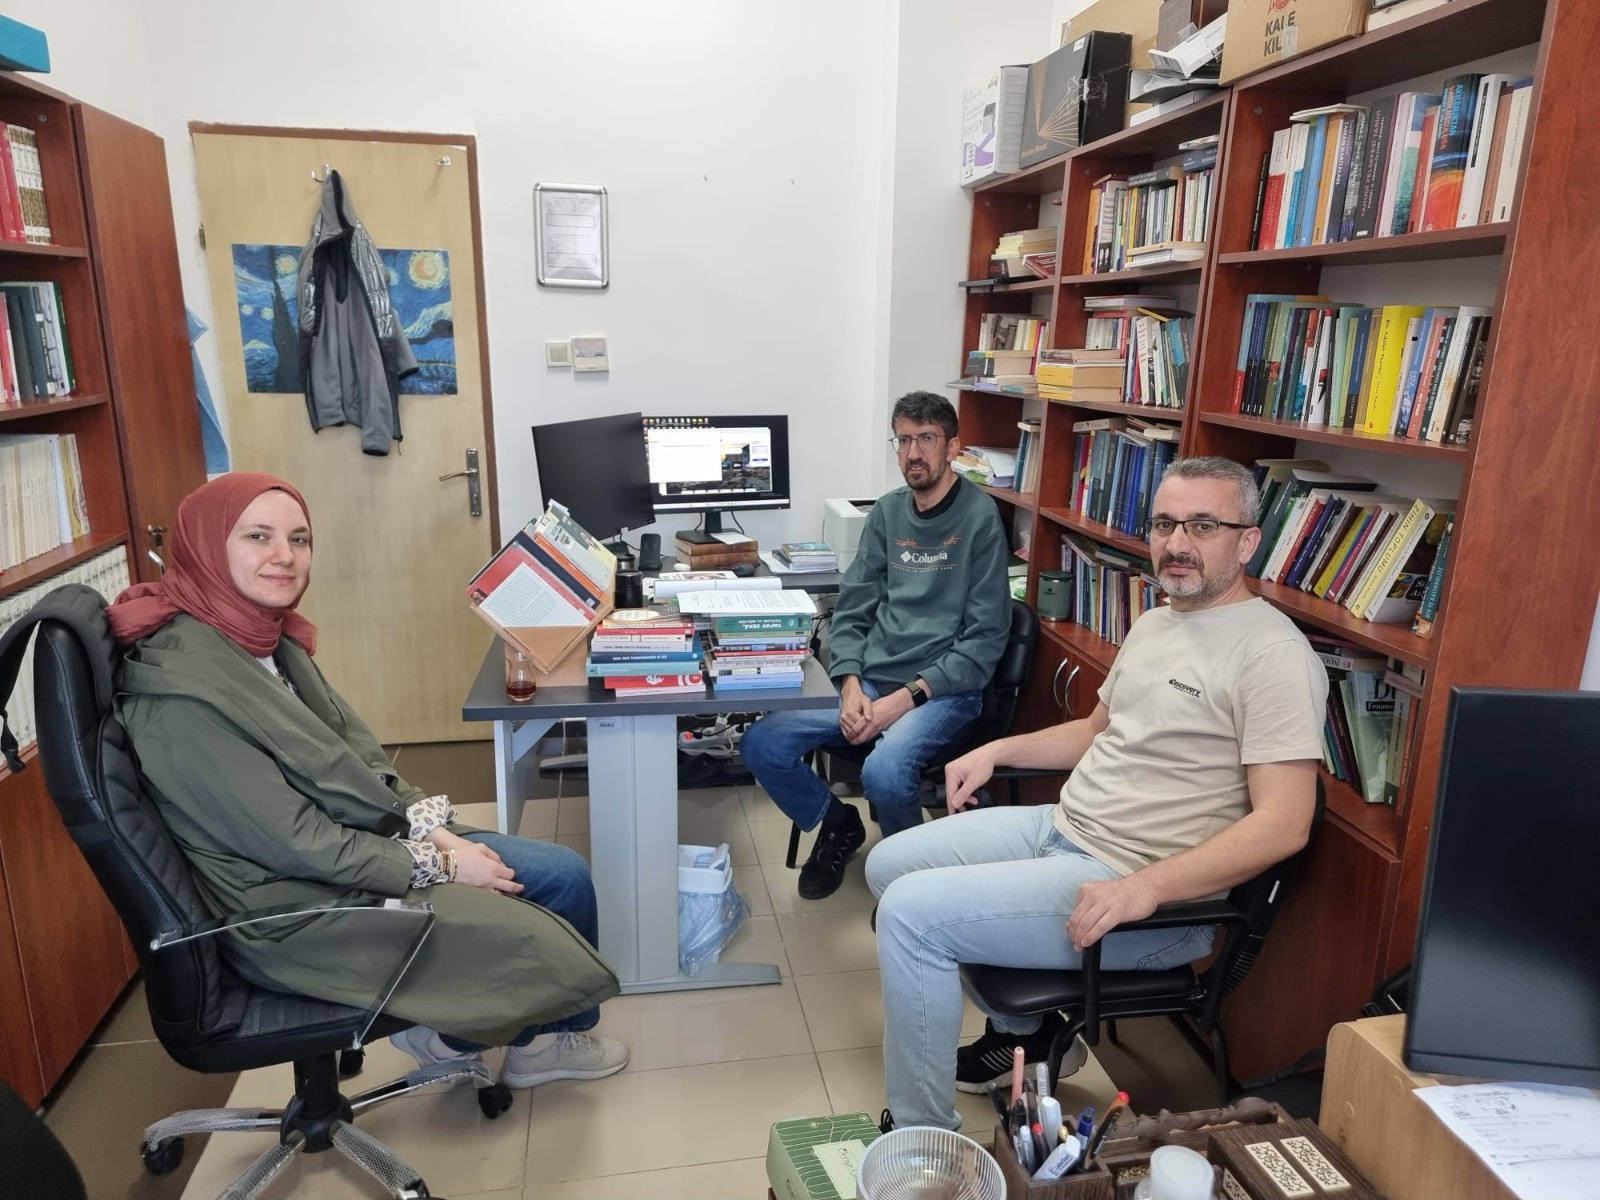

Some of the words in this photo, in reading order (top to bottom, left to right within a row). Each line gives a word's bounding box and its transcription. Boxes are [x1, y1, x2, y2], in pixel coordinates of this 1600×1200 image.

[1449, 84, 1464, 136] AKILCILIKTAN
[1340, 121, 1349, 146] ZAMAN
[1361, 186, 1370, 217] YAHUDİ
[1366, 140, 1376, 182] FELSEFESİ
[1403, 504, 1420, 531] ZİHİN
[1378, 532, 1404, 574] TOPLUMU
[1171, 678, 1201, 698] Discovery
